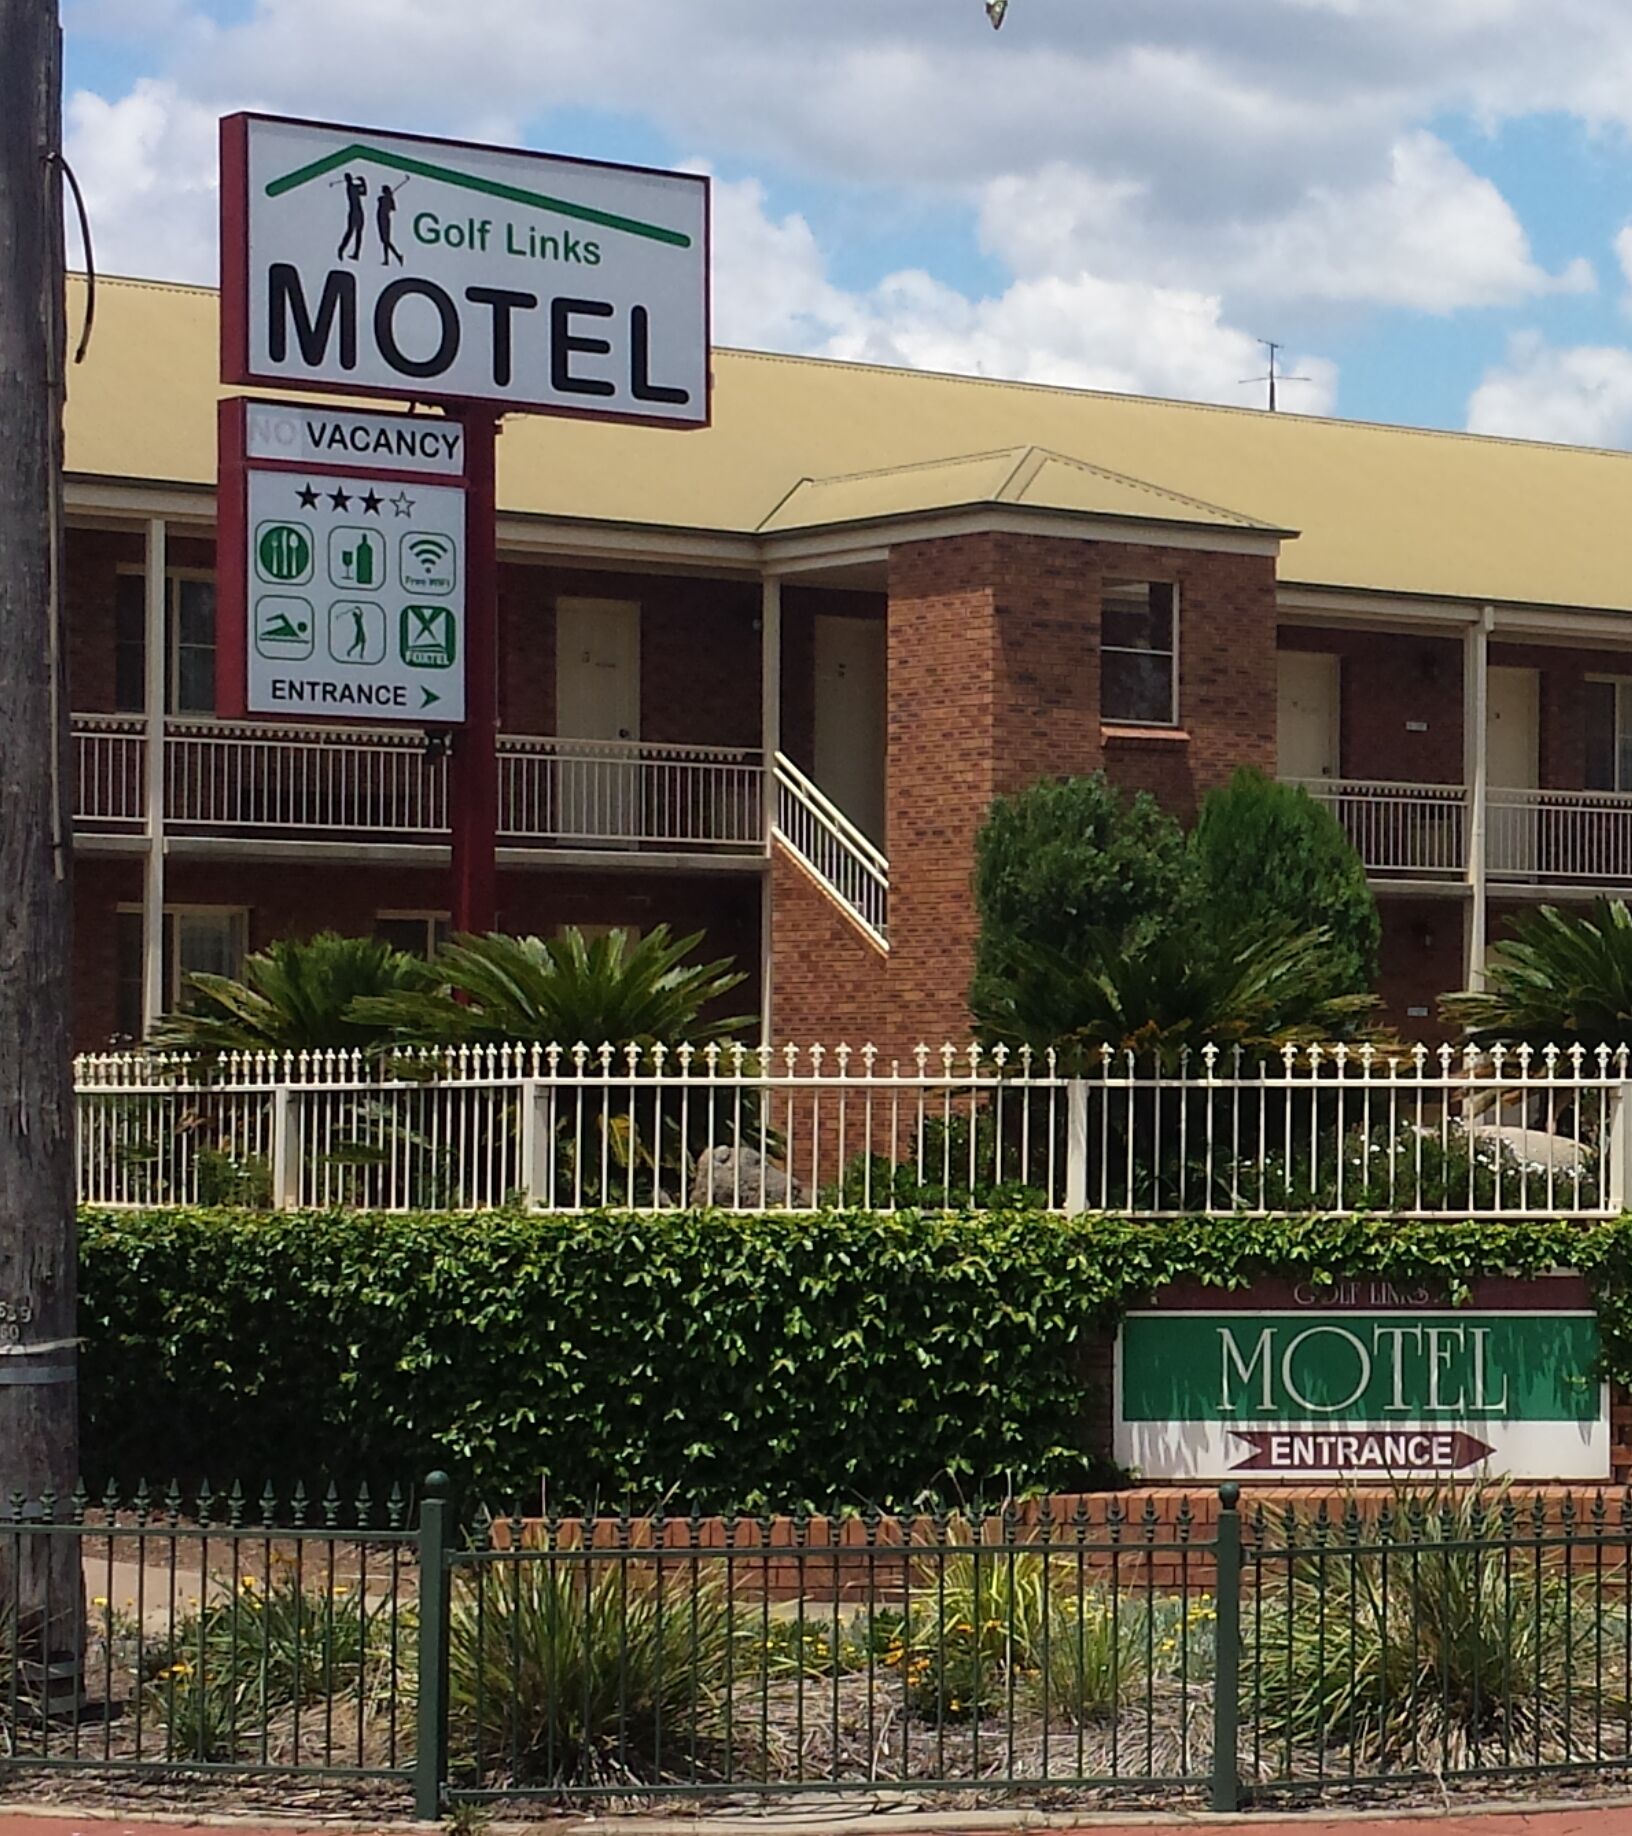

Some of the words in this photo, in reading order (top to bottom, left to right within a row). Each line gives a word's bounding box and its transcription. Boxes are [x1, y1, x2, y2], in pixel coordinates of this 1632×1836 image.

[413, 211, 492, 252] Golf
[506, 222, 601, 265] Links
[268, 262, 690, 405] MOTEL
[307, 421, 460, 460] VACANCY
[271, 679, 407, 707] ENTRANCE
[1216, 1323, 1507, 1415] MOTEL
[1270, 1435, 1453, 1467] ENTRANCE
